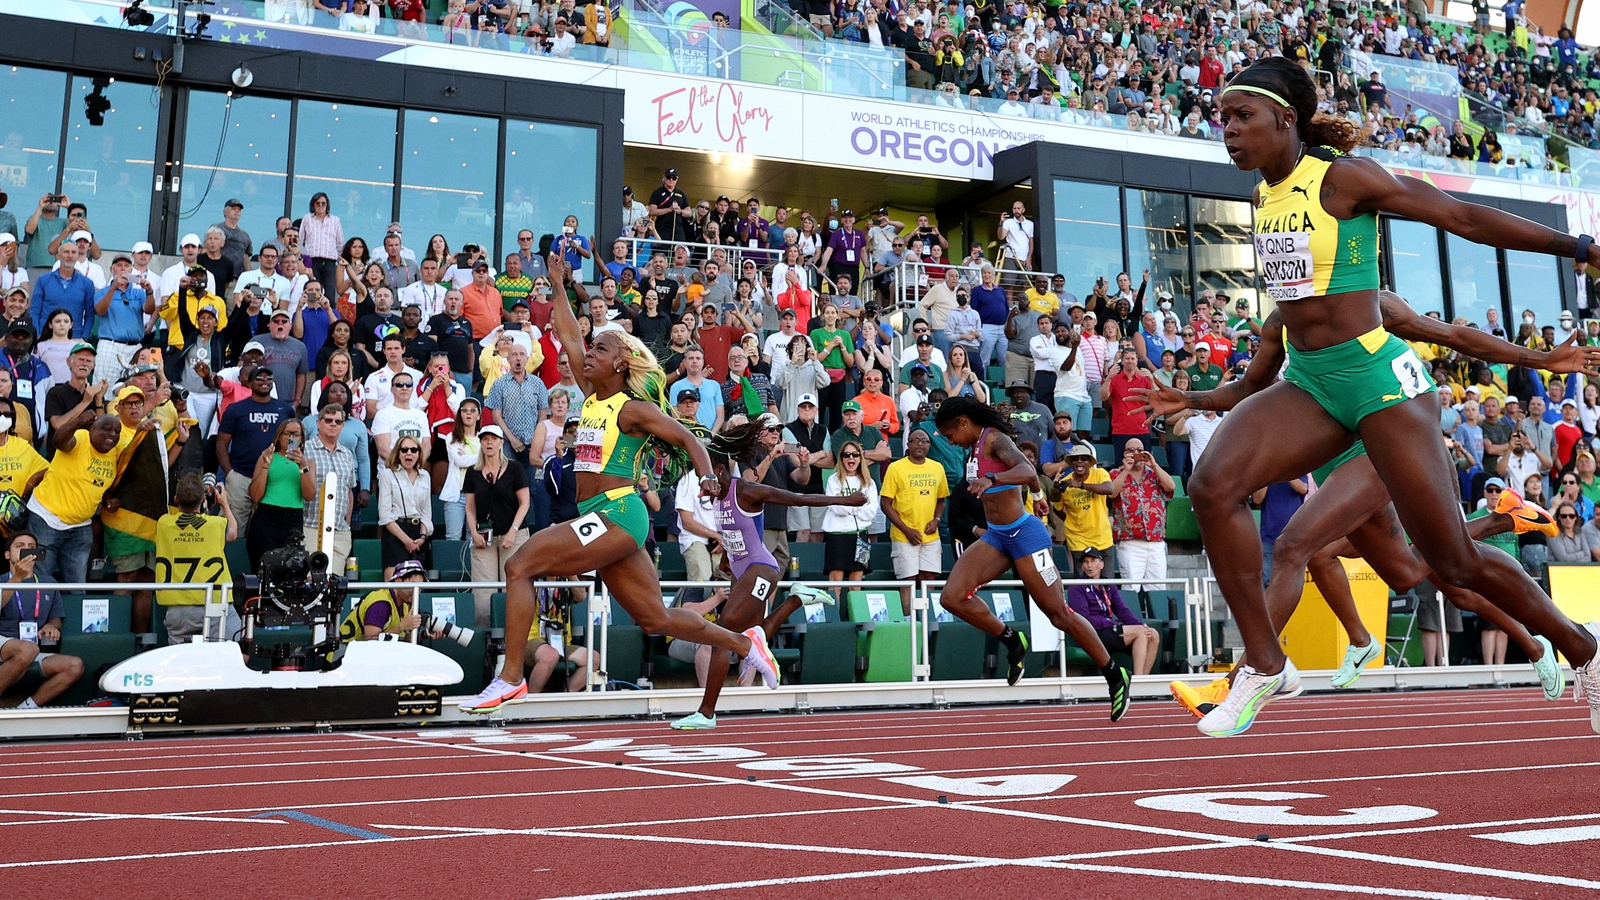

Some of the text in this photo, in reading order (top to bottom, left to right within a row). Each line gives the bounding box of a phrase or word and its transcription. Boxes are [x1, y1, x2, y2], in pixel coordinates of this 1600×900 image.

[651, 83, 774, 153] Feel the Glory
[851, 111, 1046, 142] WORLD ATHLETICS CHAMPIONSHIPS
[851, 126, 1010, 168] OREGON
[1265, 237, 1296, 255] QNB
[1403, 361, 1420, 389] 3
[249, 412, 279, 424] USATF
[909, 479, 937, 487] FASTER
[579, 522, 599, 537] 6
[1038, 552, 1046, 567] 7
[156, 556, 225, 590] 072
[1348, 572, 1378, 581] SEIKO
[757, 583, 766, 596] 8
[123, 673, 154, 687] rts
[877, 774, 1078, 797] 4
[1136, 791, 1439, 826] 3
